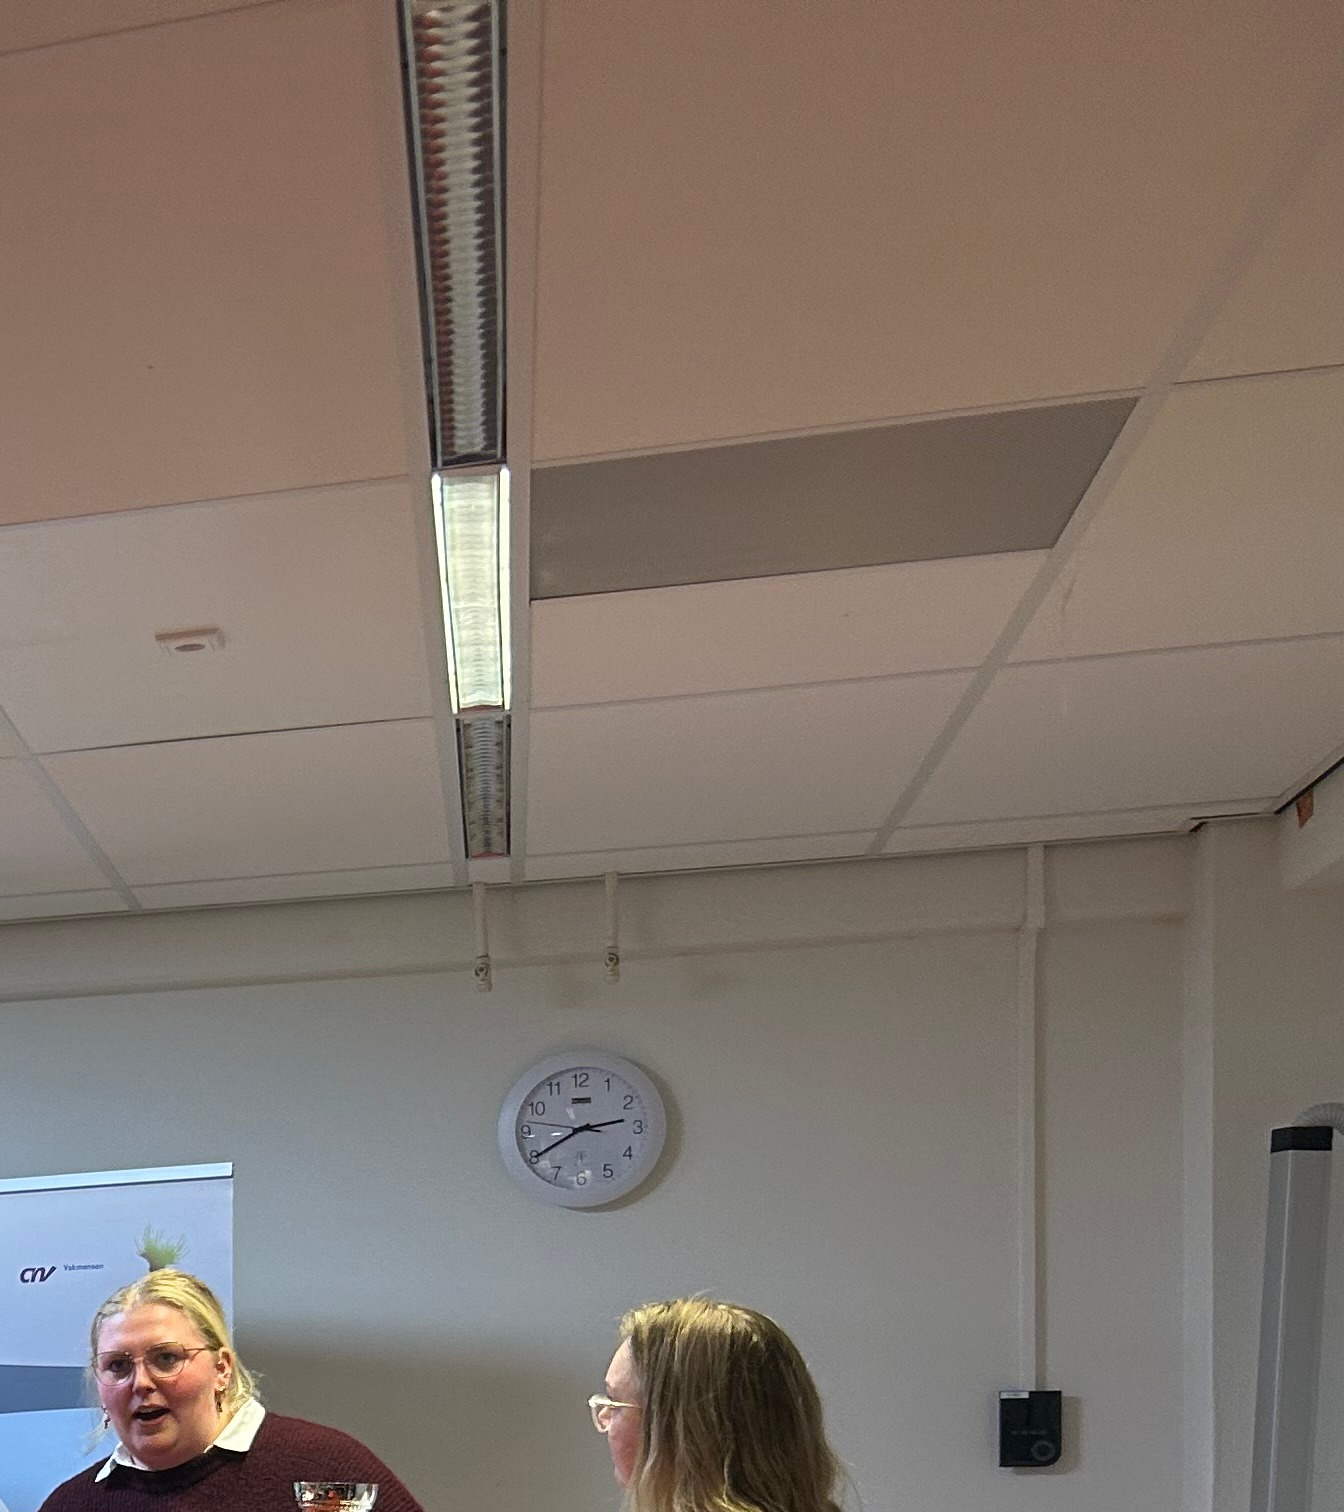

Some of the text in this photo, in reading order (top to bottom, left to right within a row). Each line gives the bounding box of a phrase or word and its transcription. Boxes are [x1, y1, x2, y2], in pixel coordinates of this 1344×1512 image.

[571, 1072, 590, 1088] 12
[604, 1077, 611, 1092] 1
[546, 1081, 561, 1096] 11
[528, 1101, 546, 1116] 10
[622, 1094, 634, 1110] 2
[520, 1124, 532, 1140] 9
[632, 1119, 644, 1135] 3
[528, 1149, 540, 1165] 8
[622, 1145, 634, 1160] 4
[551, 1165, 562, 1181] 7
[576, 1171, 587, 1186] 6
[602, 1163, 614, 1178] 5
[20, 1265, 56, 1283] CNV
